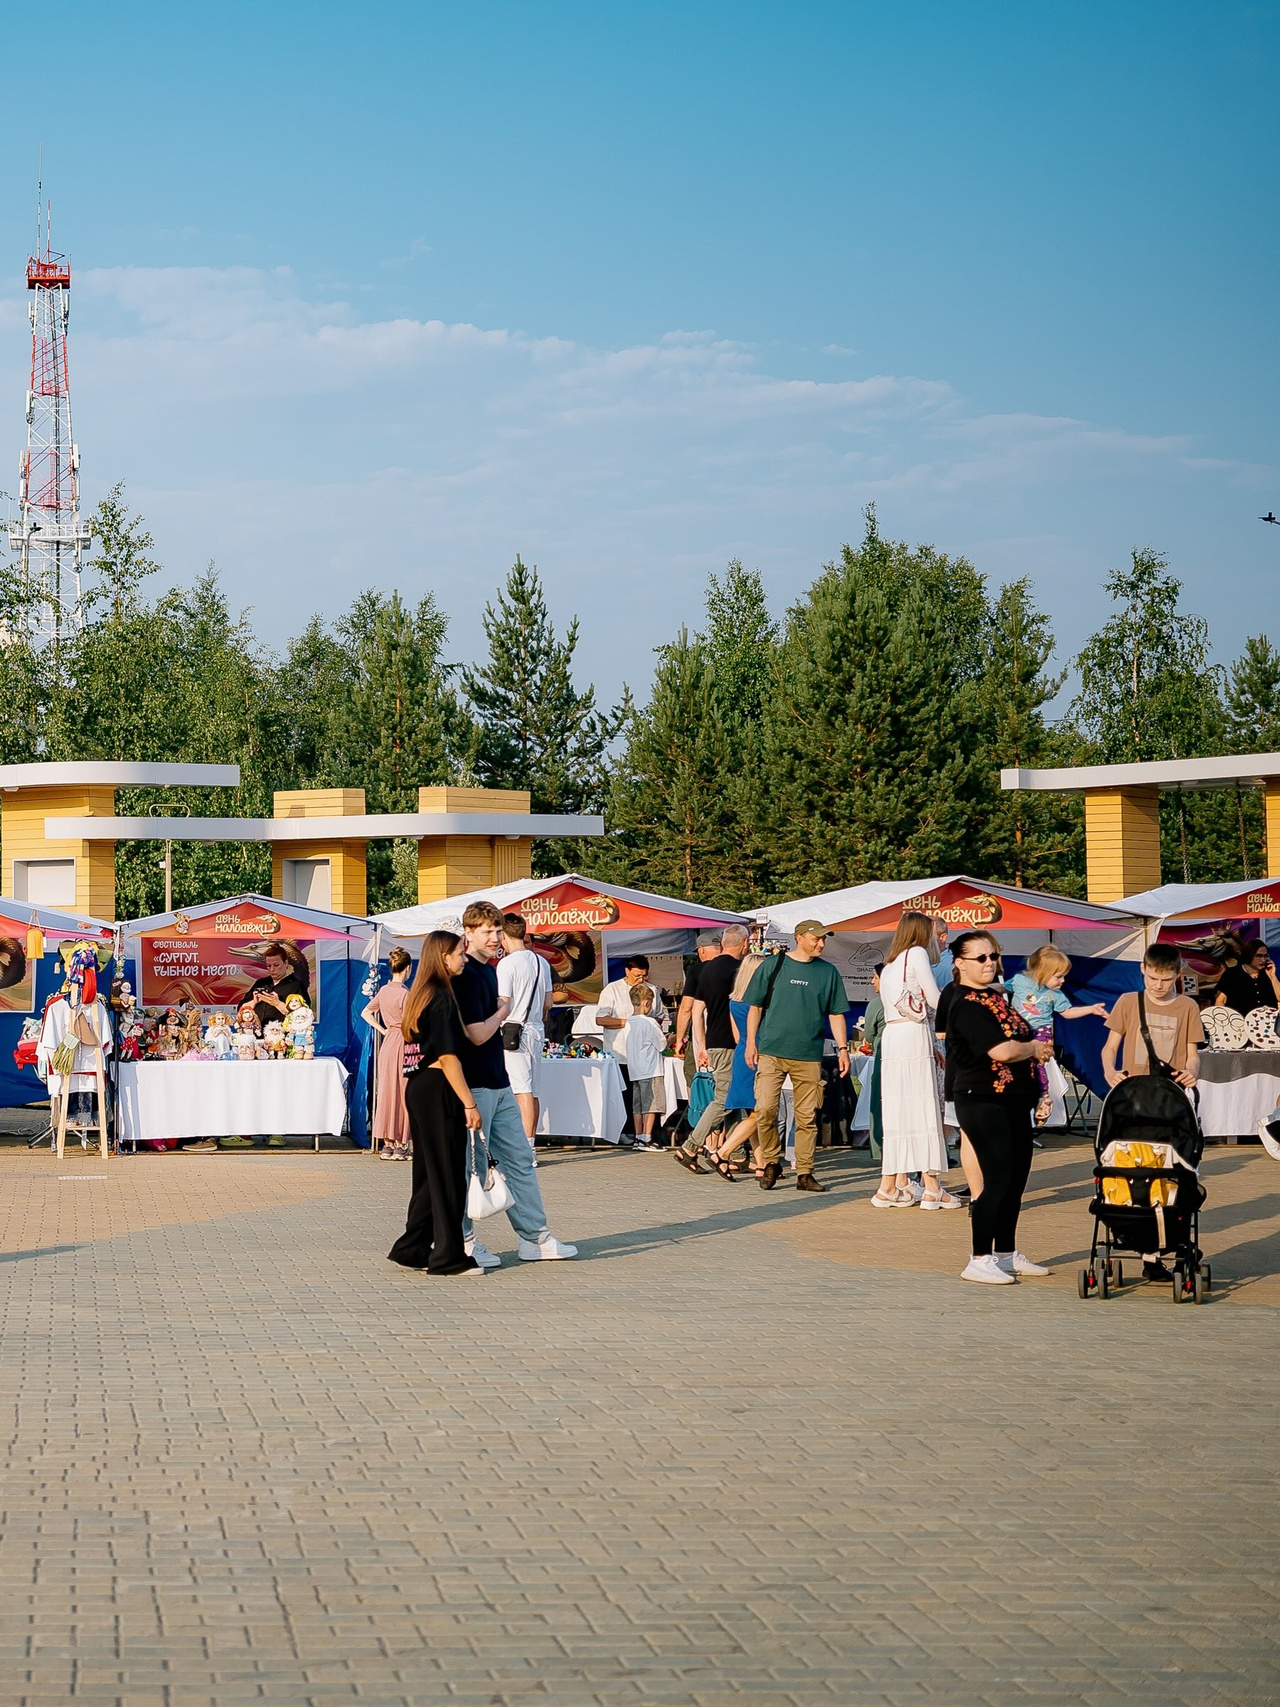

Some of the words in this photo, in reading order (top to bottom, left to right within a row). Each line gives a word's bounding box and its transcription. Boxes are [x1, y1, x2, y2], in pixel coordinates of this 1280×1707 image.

[1246, 893, 1273, 903] ДЕНЬ
[520, 897, 559, 912] ДЕНЬ
[215, 914, 241, 923] ДЕНЬ
[903, 906, 982, 923] ОДЁЖИ
[153, 952, 200, 963] «СУРГУТ.
[153, 965, 199, 976] РЫБНОЕ
[201, 965, 243, 976] МЕСТО»
